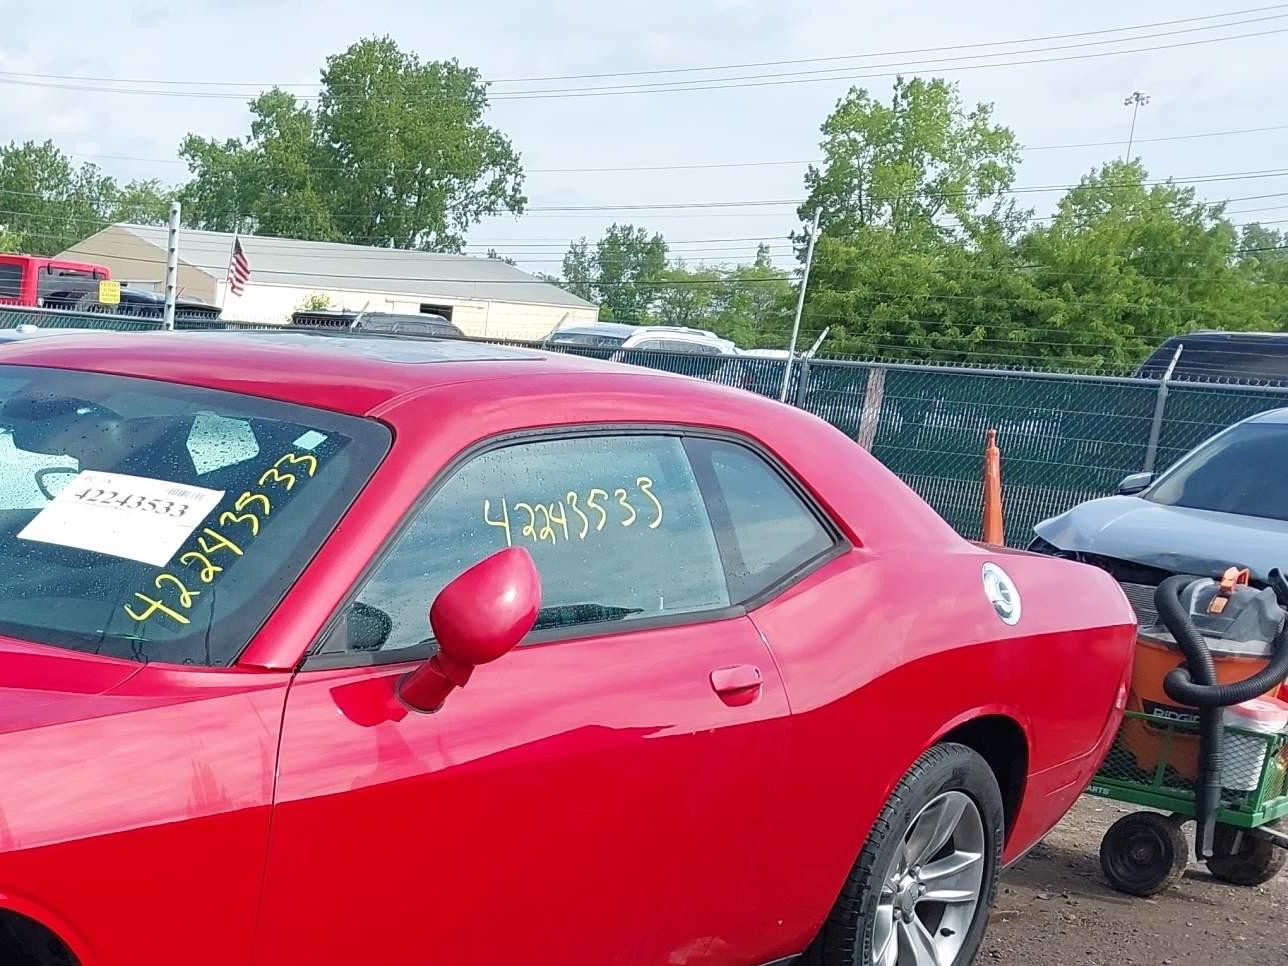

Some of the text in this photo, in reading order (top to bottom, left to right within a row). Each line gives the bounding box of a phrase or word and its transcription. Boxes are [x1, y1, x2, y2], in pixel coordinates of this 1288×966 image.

[74, 487, 190, 518] 42243533
[484, 476, 663, 547] 42243533
[123, 453, 318, 625] 42243533
